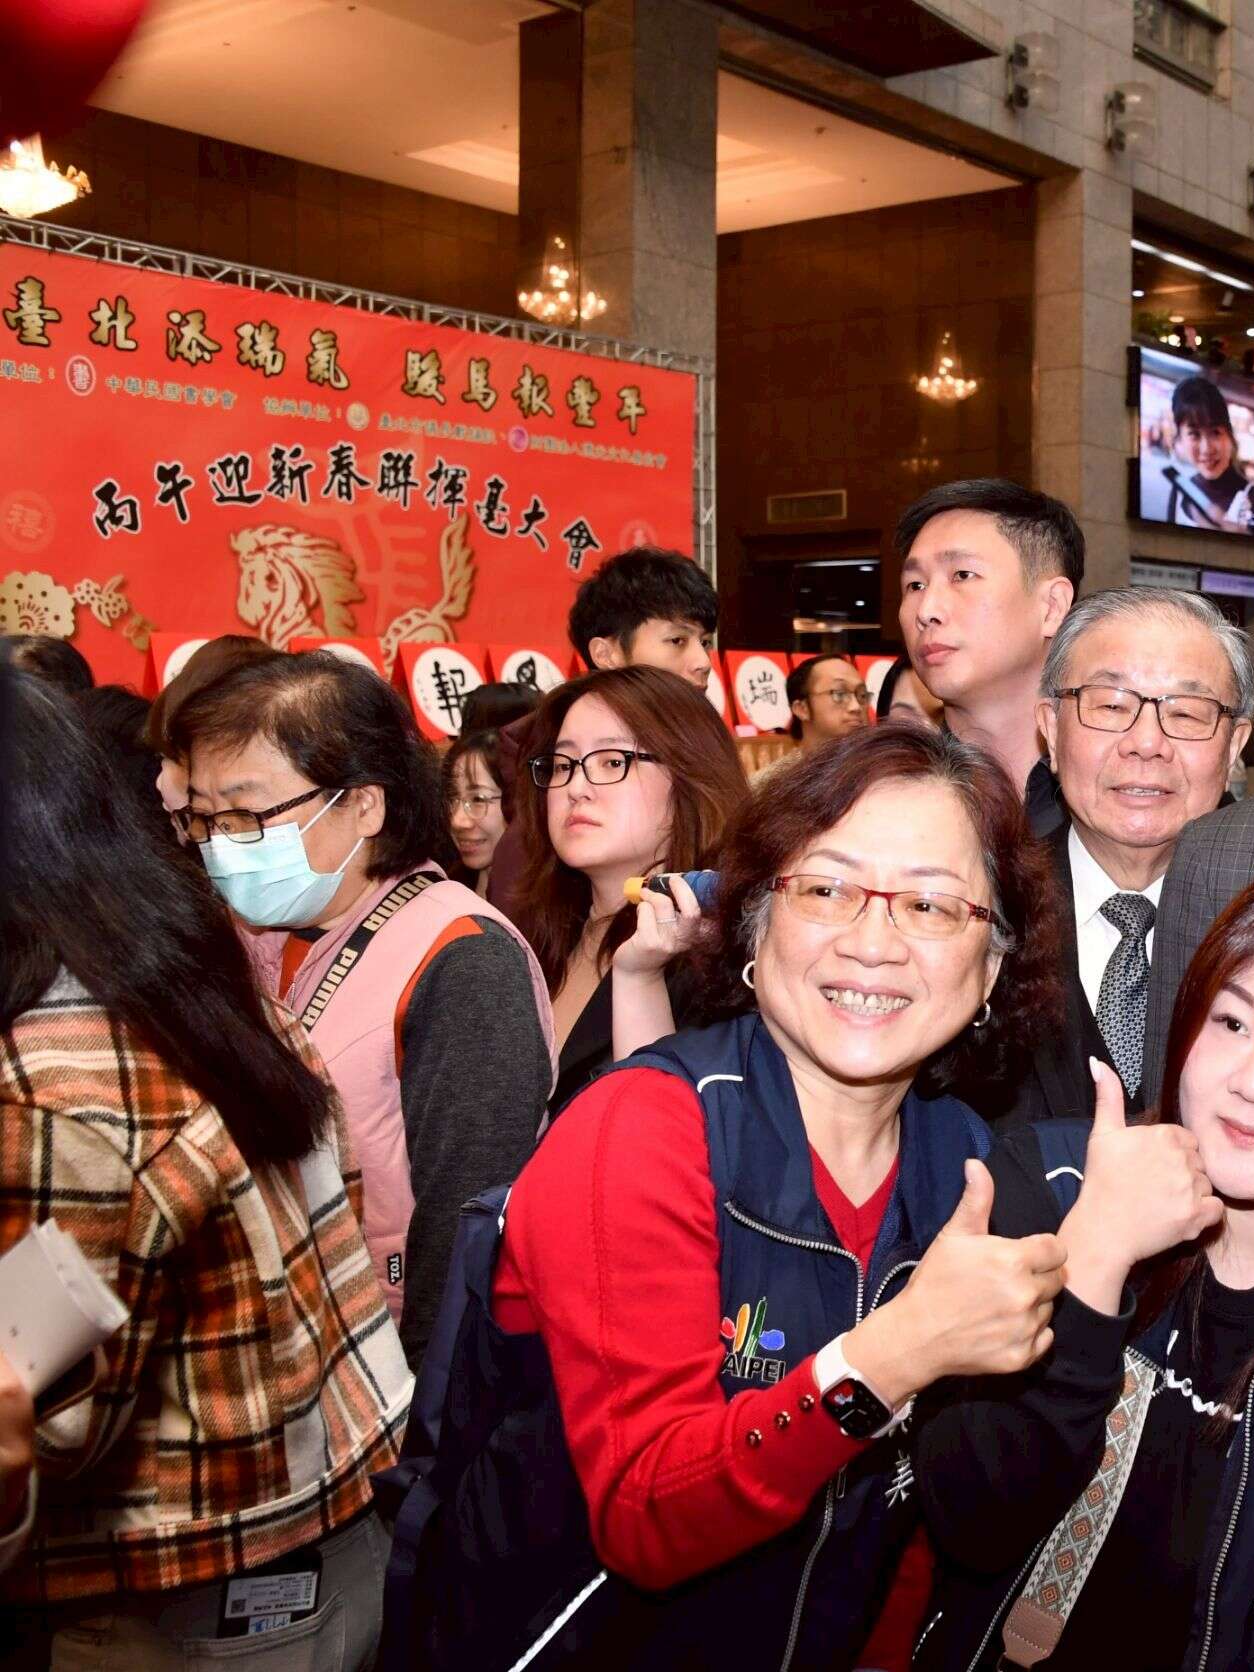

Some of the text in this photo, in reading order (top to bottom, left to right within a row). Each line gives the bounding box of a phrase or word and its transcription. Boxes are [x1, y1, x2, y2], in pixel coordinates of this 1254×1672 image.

[93, 444, 602, 570] 丙午迎新春聯揮毫大會
[722, 1352, 787, 1384] AIPEI
